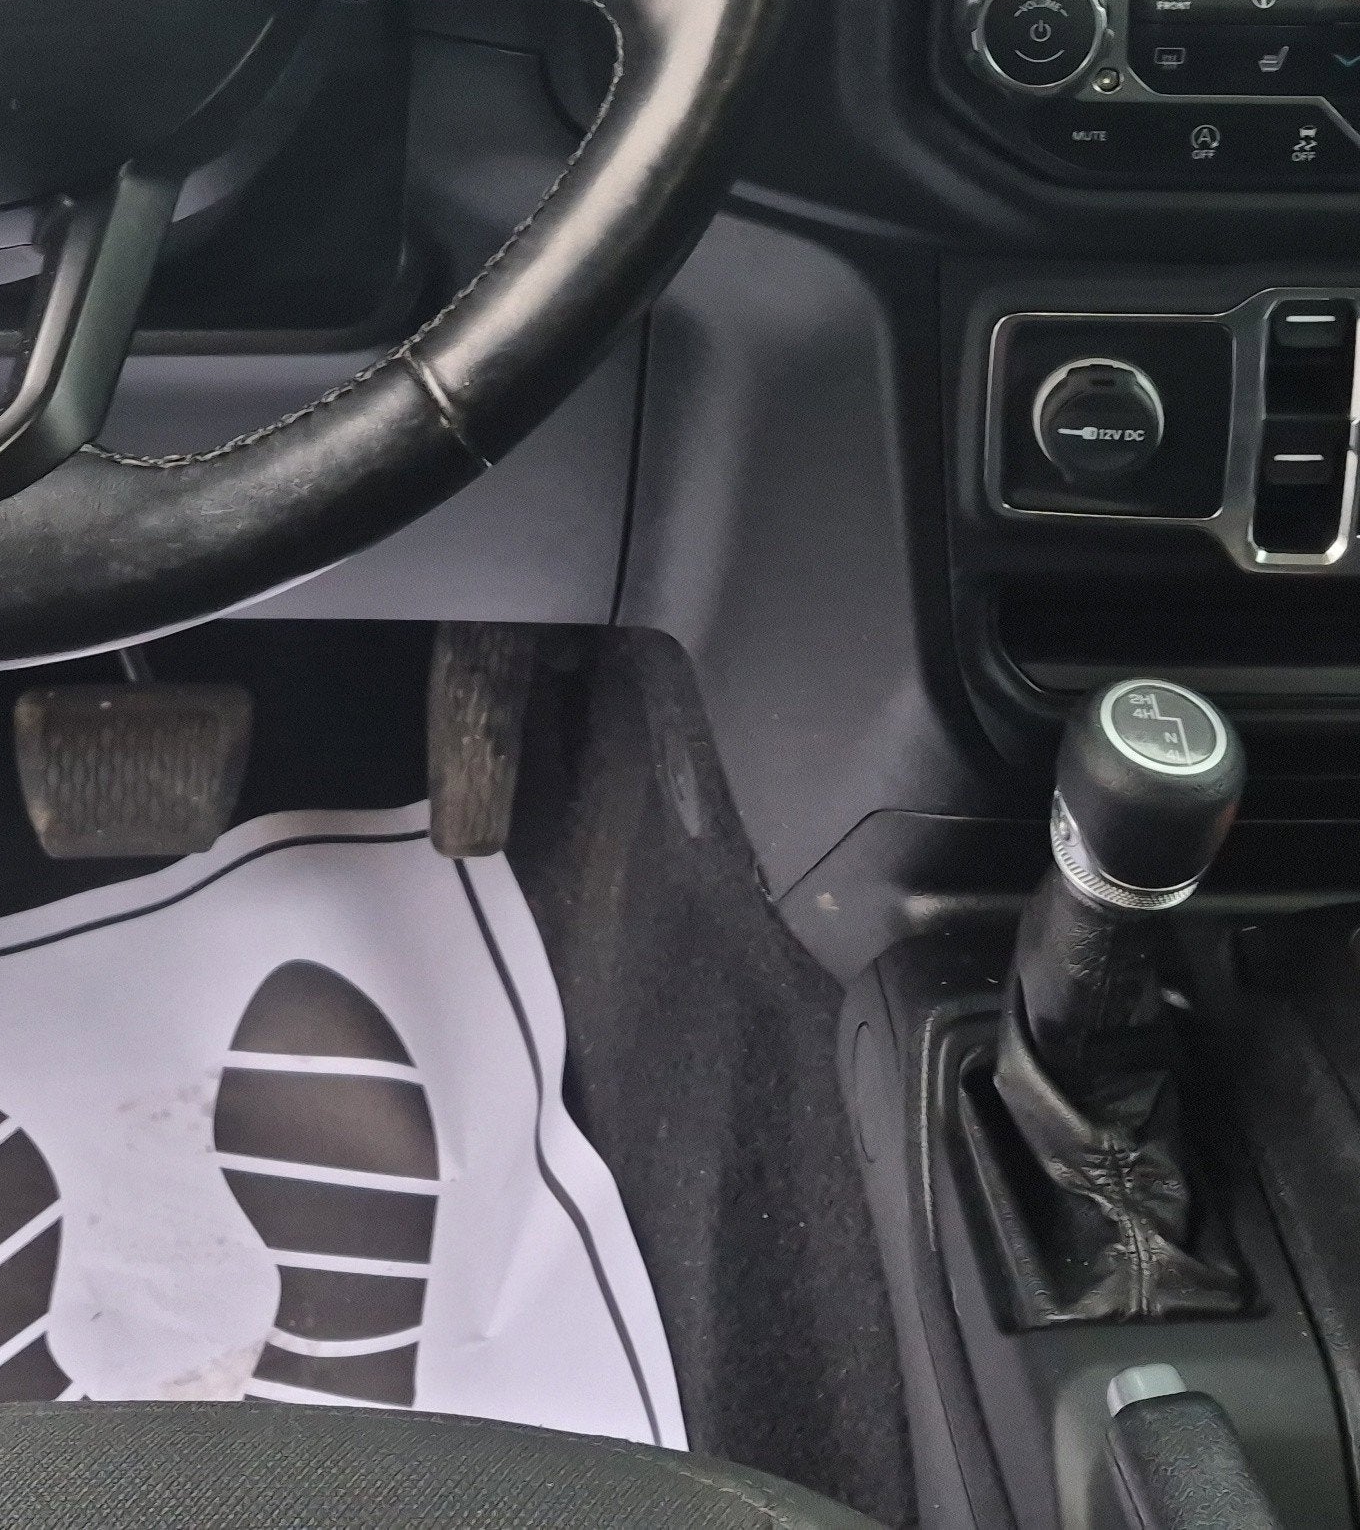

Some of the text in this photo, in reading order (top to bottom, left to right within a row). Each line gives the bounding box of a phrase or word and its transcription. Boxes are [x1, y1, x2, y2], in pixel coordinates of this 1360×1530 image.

[1072, 130, 1108, 142] MUTE
[1191, 149, 1217, 160] OFF
[1292, 151, 1317, 162] OFF
[1099, 429, 1146, 442] 12V DC
[1164, 731, 1178, 744] N
